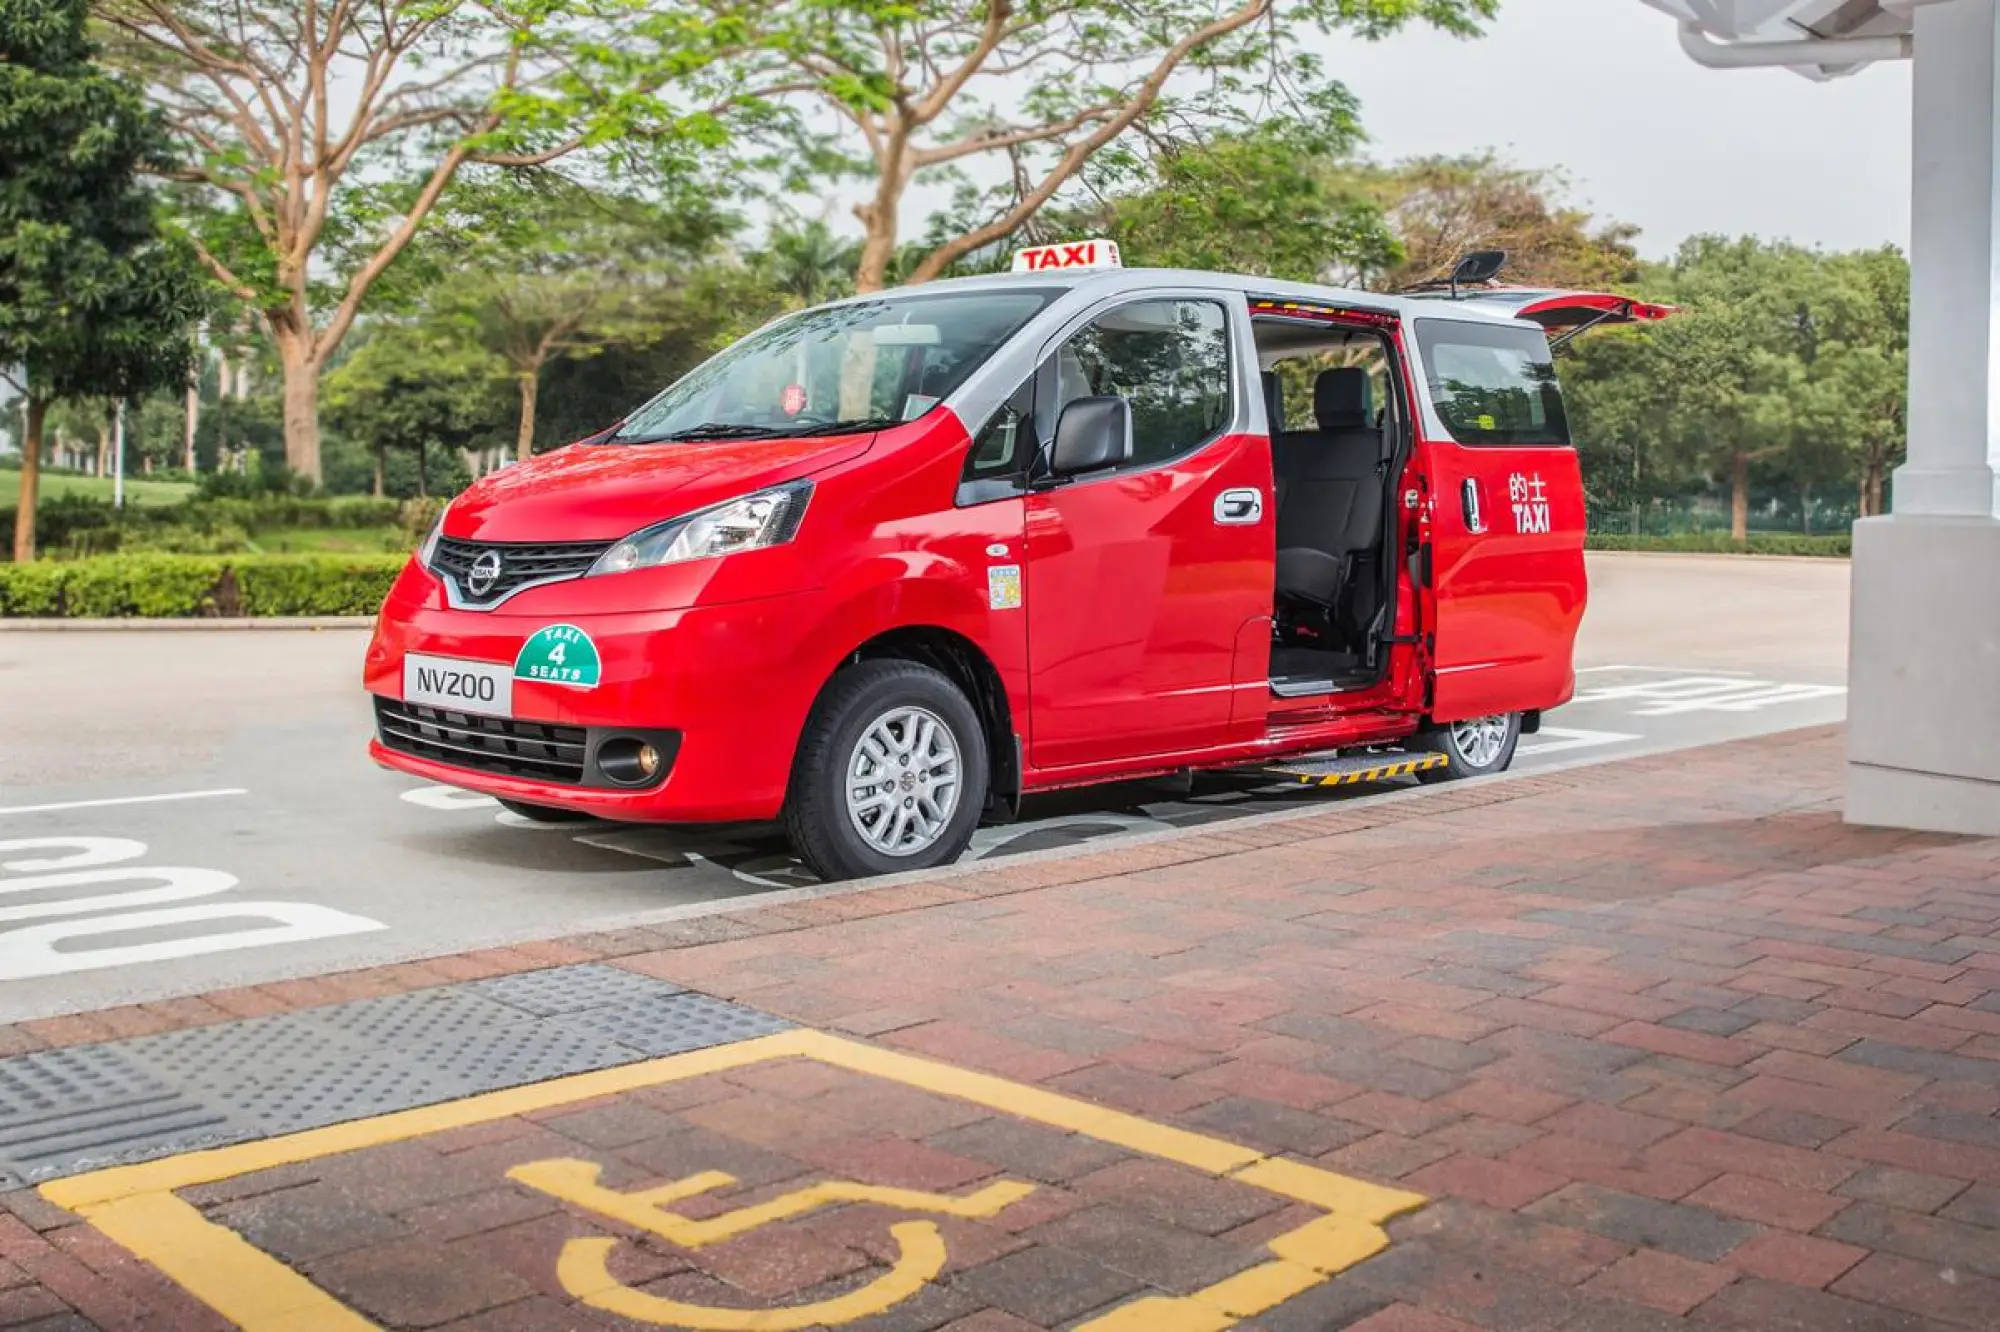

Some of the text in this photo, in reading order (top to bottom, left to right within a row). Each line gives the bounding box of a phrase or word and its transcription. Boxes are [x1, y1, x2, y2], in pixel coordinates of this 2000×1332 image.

[1021, 243, 1095, 270] TAXI
[1509, 472, 1547, 501] 的士
[1512, 503, 1550, 533] TAXI
[545, 628, 580, 644] TAXI
[547, 642, 566, 665] 4
[417, 667, 494, 701] NV200
[530, 665, 581, 680] SEATS
